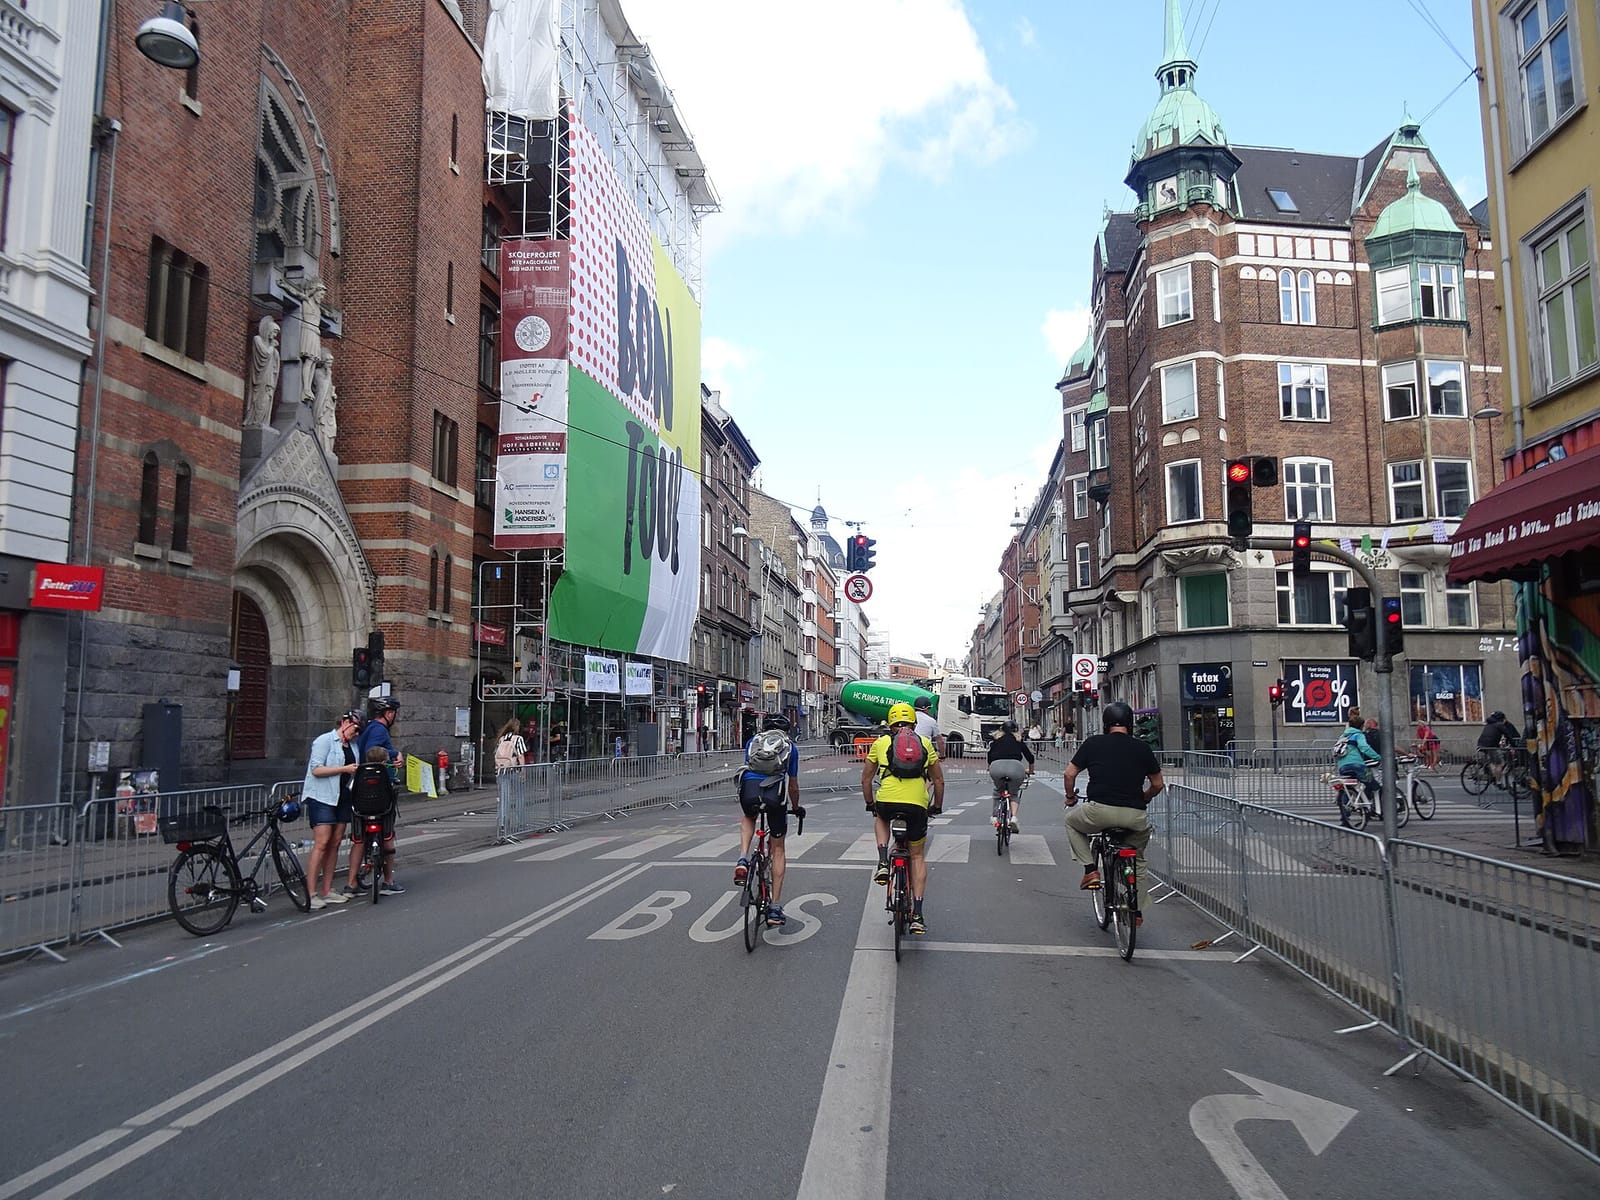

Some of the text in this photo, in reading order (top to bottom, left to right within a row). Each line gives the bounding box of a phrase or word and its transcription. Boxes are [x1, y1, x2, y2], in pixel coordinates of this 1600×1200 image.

[508, 251, 561, 259] SKOLEPROJEKT
[615, 236, 674, 432] BON
[503, 483, 514, 491] AC
[624, 420, 683, 575] TOUR
[1451, 540, 1465, 558] All
[1468, 537, 1482, 553] You
[1484, 528, 1505, 549] Need
[1508, 525, 1517, 541] Is
[1555, 506, 1573, 528] and
[1495, 637, 1520, 651] 7-2
[1196, 684, 1217, 693] FOOD
[853, 692, 862, 700] HC
[861, 693, 880, 703] PUMPS
[586, 890, 839, 946] BUS
